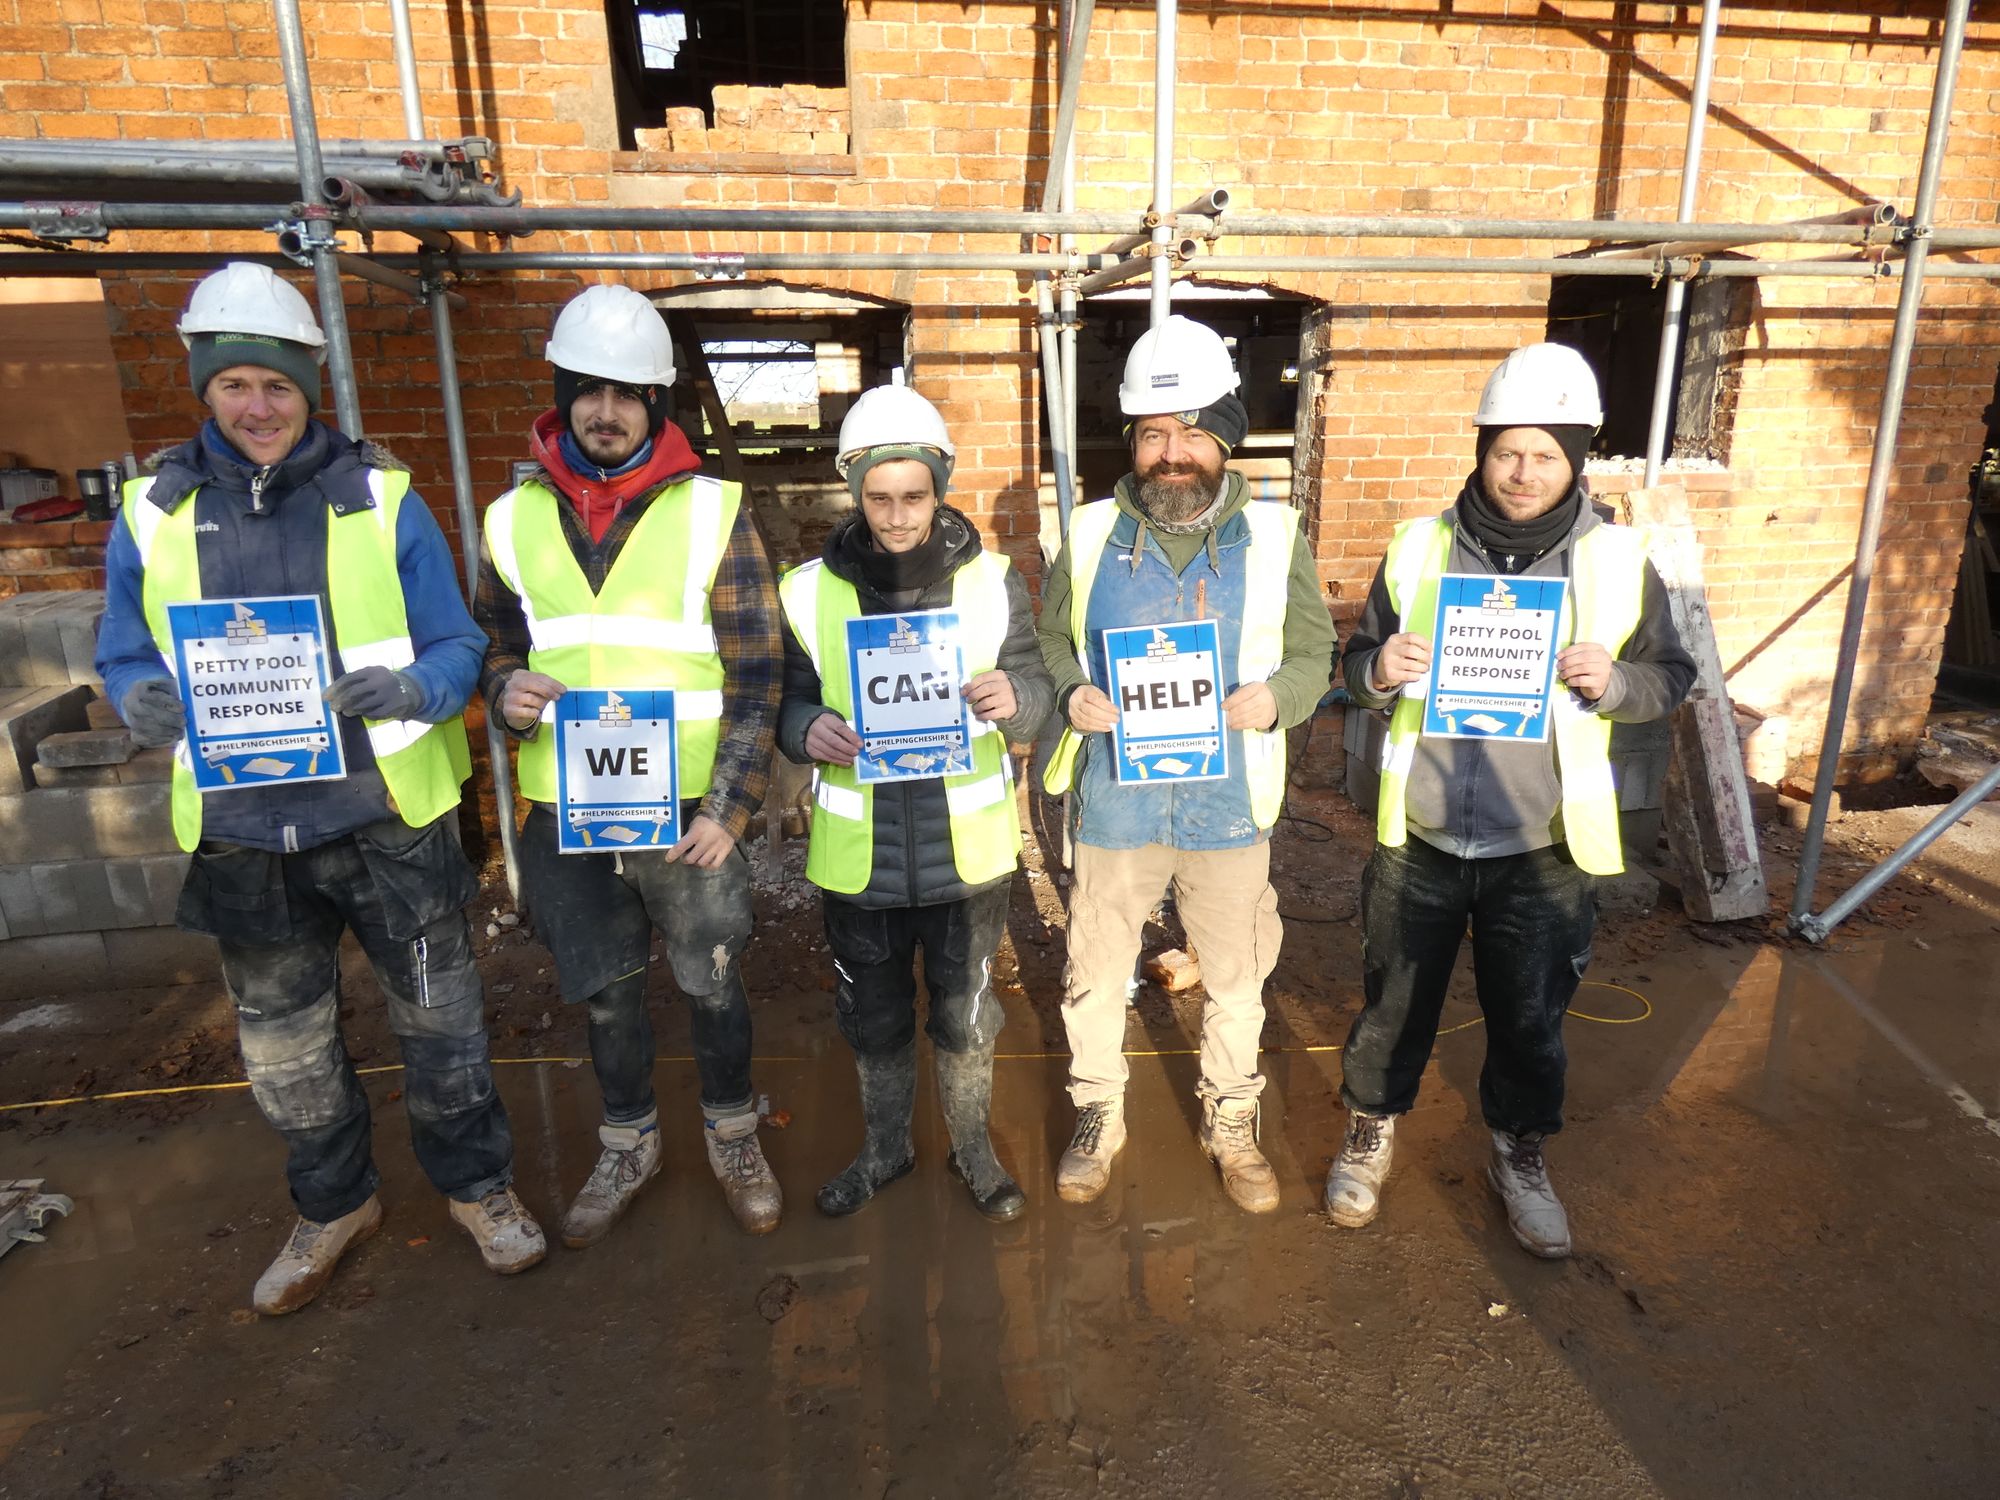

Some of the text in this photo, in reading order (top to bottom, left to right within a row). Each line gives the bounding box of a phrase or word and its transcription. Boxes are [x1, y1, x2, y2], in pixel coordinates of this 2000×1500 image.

[1449, 625, 1543, 641] PETTY POOL
[1443, 645, 1545, 661] COMMUNITY
[194, 655, 307, 674] PETTY POOL
[1451, 665, 1531, 680] RESPONSE
[193, 677, 314, 697] COMMUNITY
[867, 671, 950, 705] CAN
[1121, 679, 1213, 712] HELP
[1449, 697, 1527, 708] #HELPINGCHESHIRE
[209, 701, 305, 719] RESPONSE
[216, 736, 312, 751] #HELPINGCHESHIRE
[876, 734, 950, 746] #HELPINGCHESHIRE
[1136, 740, 1207, 750] #HELPINGCHESHIRE
[585, 747, 649, 777] WE
[580, 809, 658, 817] #HELPINGCHESHIRE
